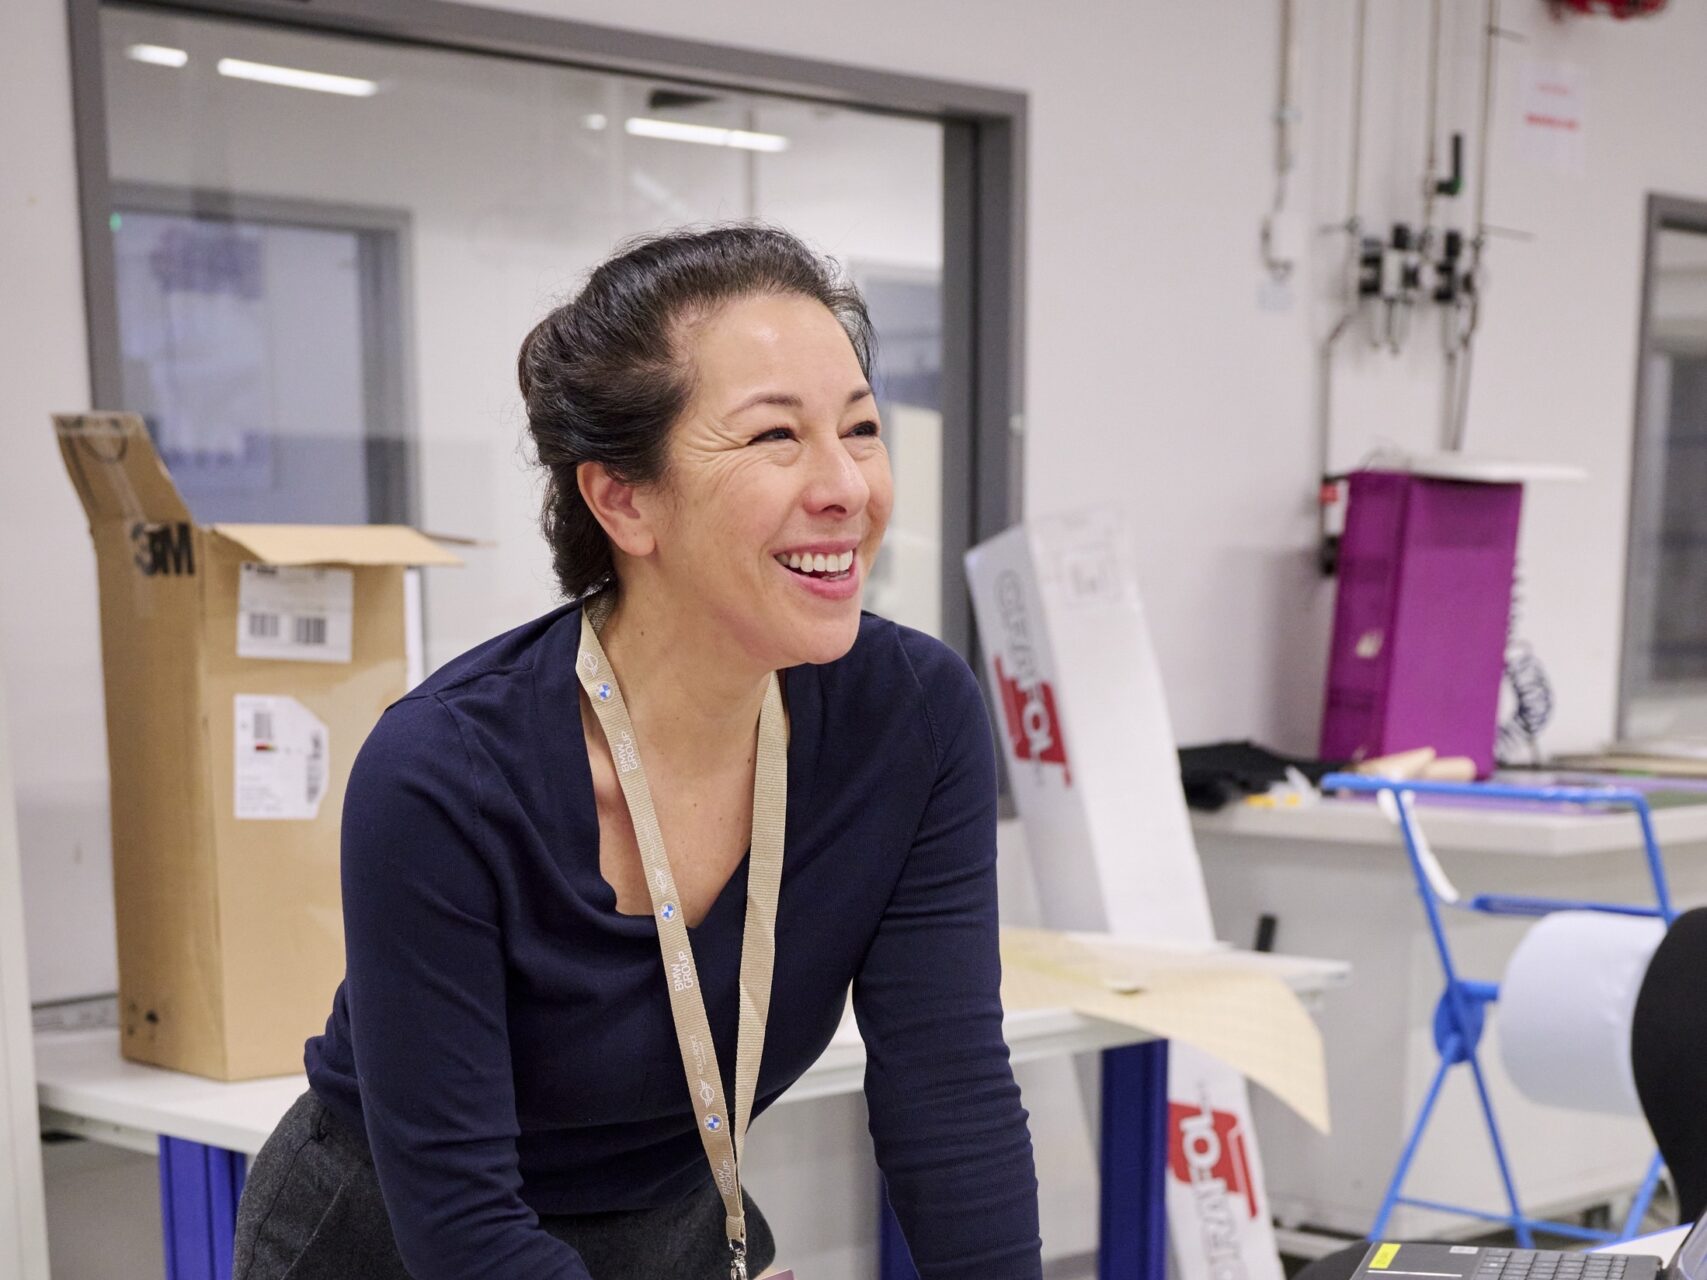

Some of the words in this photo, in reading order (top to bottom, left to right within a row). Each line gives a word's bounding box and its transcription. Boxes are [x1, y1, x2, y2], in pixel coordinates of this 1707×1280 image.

[131, 522, 196, 577] 3M
[616, 744, 630, 772] BMW
[621, 731, 638, 770] GROUP
[671, 964, 684, 992] BMW
[679, 951, 694, 989] GROUP
